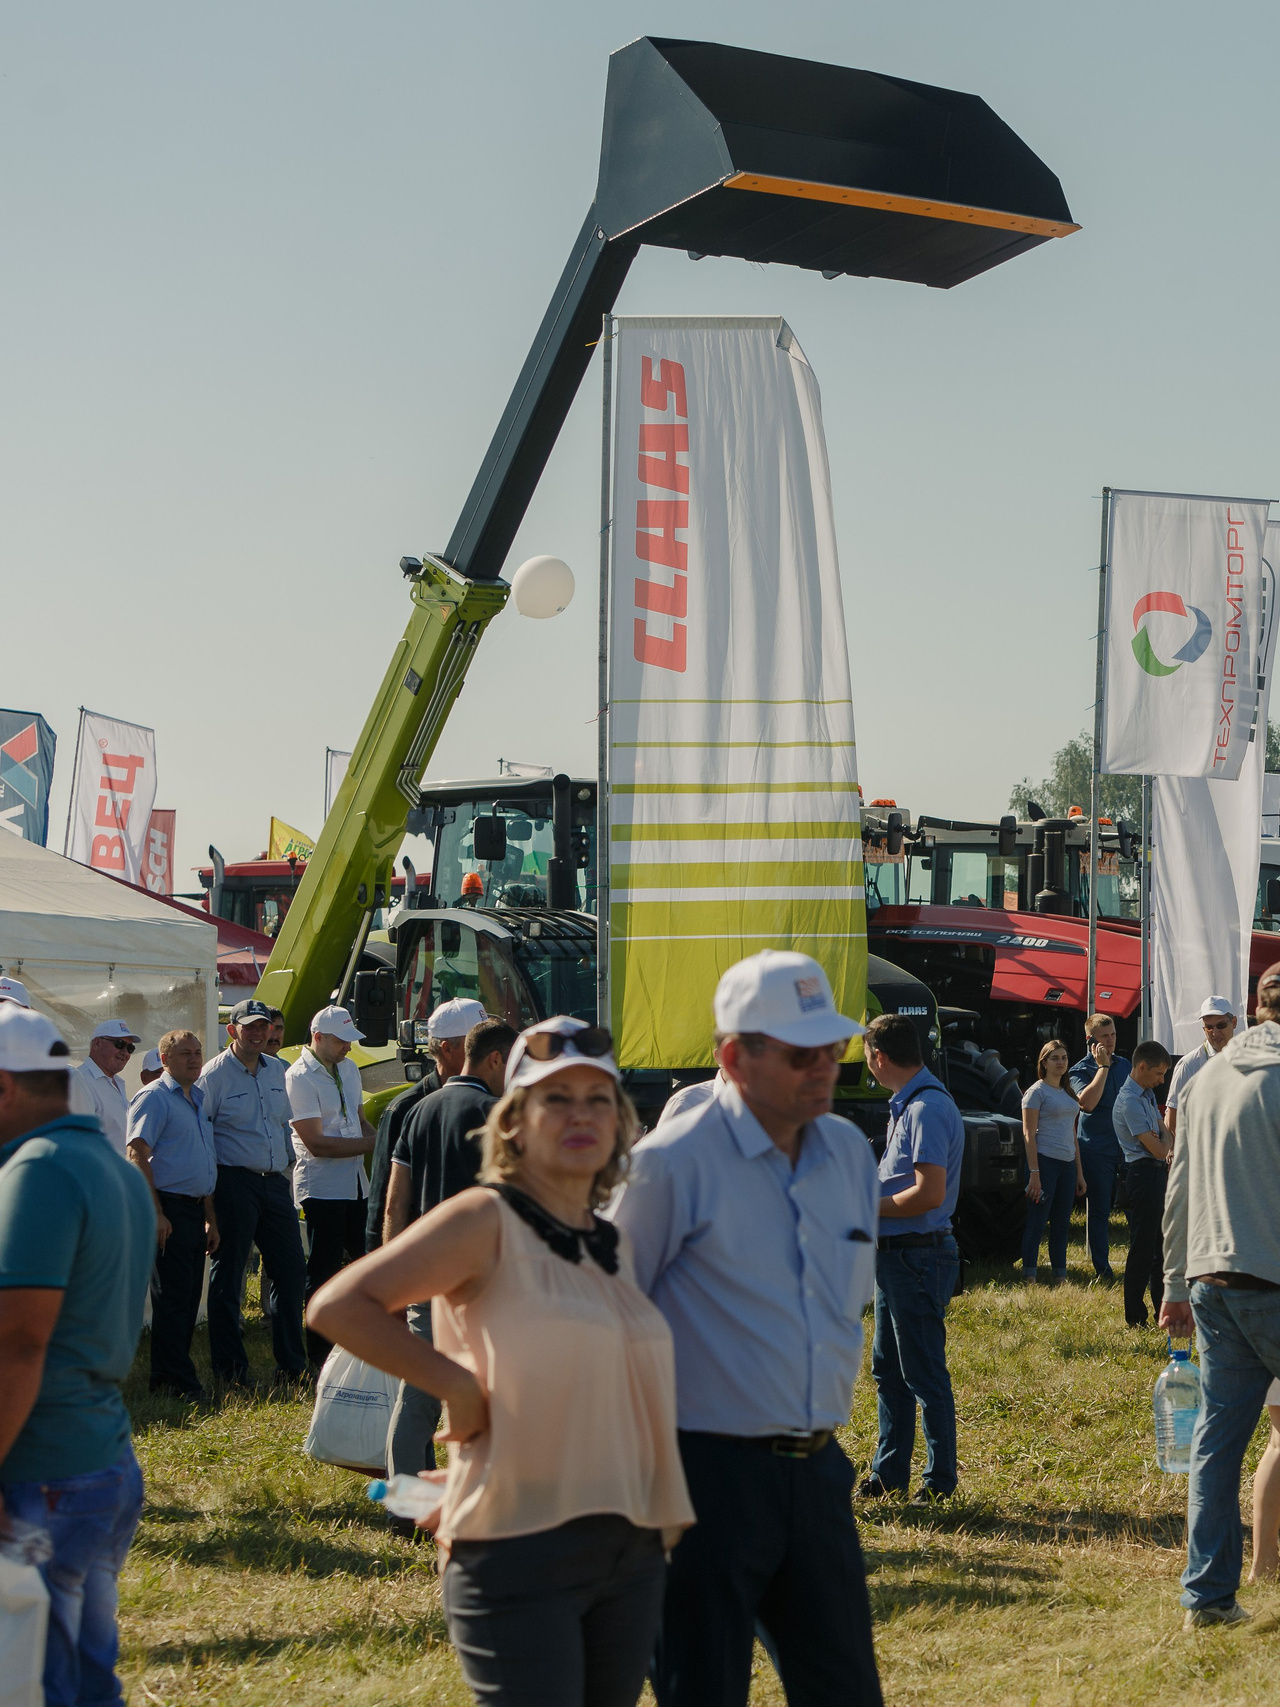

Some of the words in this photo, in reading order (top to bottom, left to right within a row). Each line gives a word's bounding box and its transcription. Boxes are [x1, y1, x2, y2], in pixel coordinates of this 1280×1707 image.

[633, 355, 690, 674] CLAAS
[1213, 507, 1245, 768] ТЕХПРОМТОРГ
[145, 827, 168, 896] SCH
[885, 929, 983, 937] РОСТСЕЛЬМАШ
[996, 935, 1049, 948] 2400
[898, 1006, 928, 1016] CLAAS
